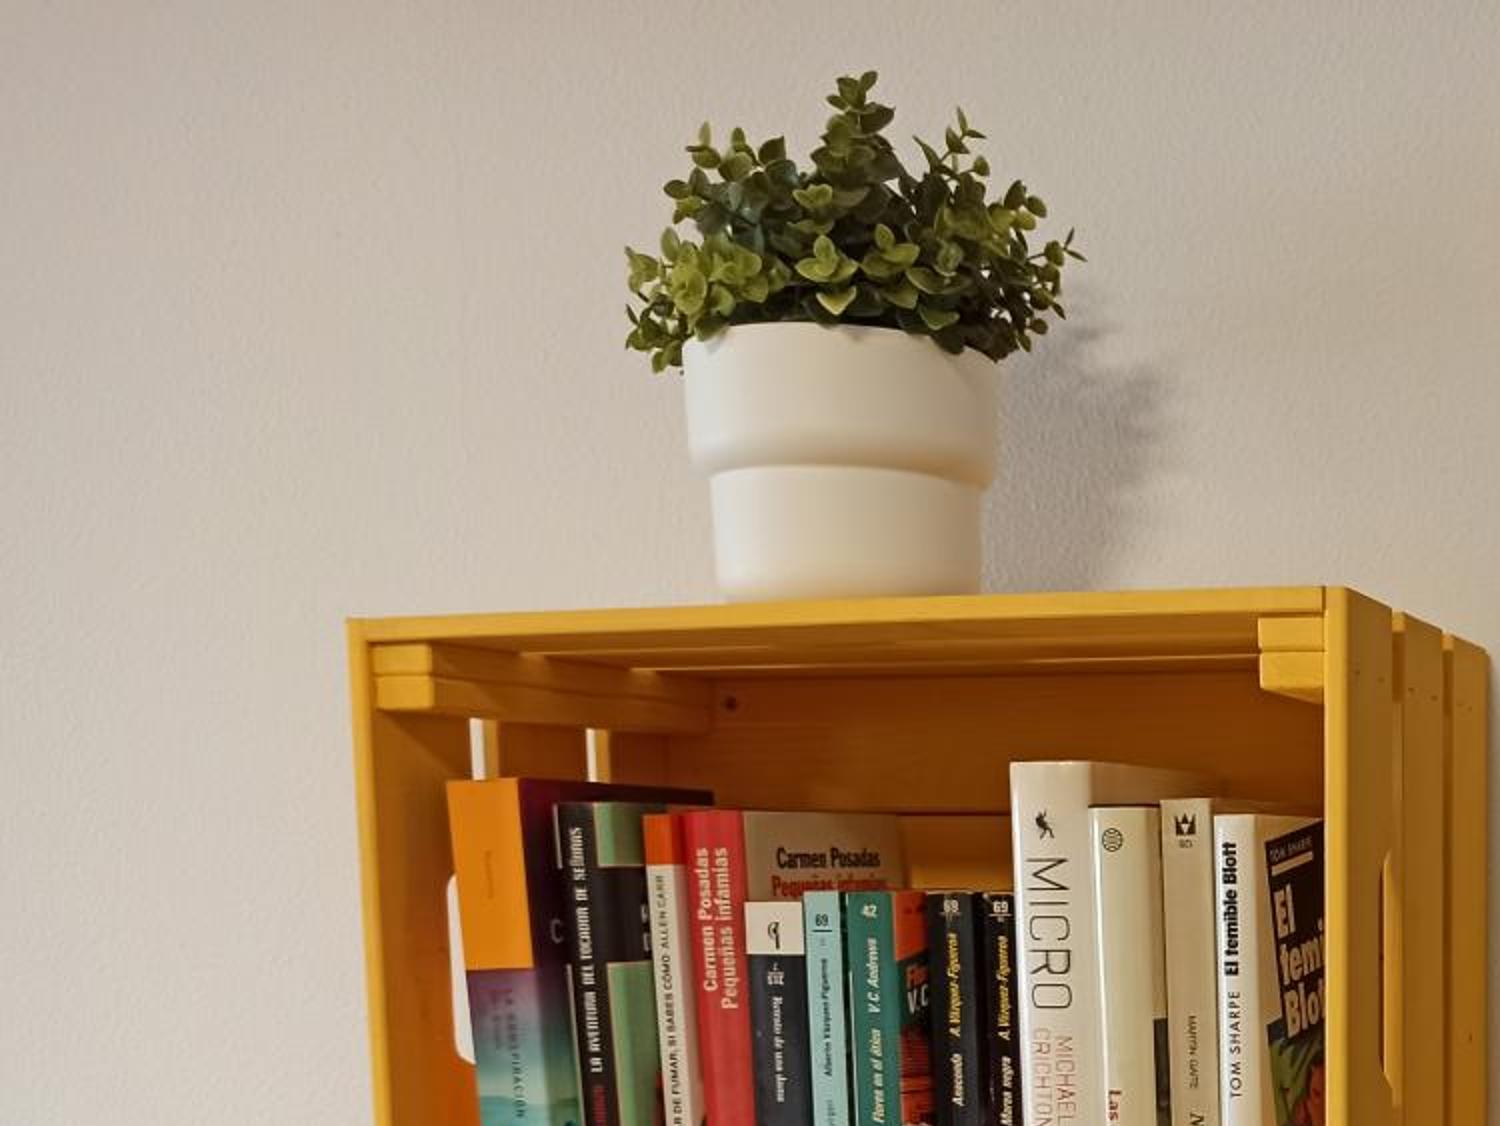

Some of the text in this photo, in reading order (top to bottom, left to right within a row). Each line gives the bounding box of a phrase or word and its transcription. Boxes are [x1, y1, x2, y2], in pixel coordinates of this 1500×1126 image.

[569, 826, 586, 881] SEÑORAS
[775, 846, 881, 869] Carmen Posadas
[574, 886, 587, 902] DE
[655, 875, 666, 909] CARR
[694, 847, 718, 991] Carmen Posadas
[712, 846, 740, 1010] Pequeñas infamias
[1273, 884, 1297, 938] El
[575, 905, 593, 959] TOCADOR
[657, 910, 670, 949] ALLEN
[1025, 856, 1073, 1010] MICRO
[580, 964, 596, 985] DEL
[865, 936, 880, 988] Andrews
[1221, 842, 1244, 1099] TOM SHARPE El temible Blott
[584, 991, 602, 1052] AVENTURA
[664, 992, 676, 1033] SABES
[772, 996, 784, 1036] Retrato
[666, 1034, 676, 1048] SI
[773, 1037, 785, 1051] de
[869, 1028, 883, 1057] ático
[590, 1057, 604, 1073] LA
[775, 1053, 785, 1072] una
[870, 1058, 883, 1071] el
[872, 1072, 884, 1087] en
[998, 1056, 1015, 1089] negra
[775, 1075, 787, 1103] dama
[950, 1053, 966, 1107] Anaconda
[671, 1098, 682, 1115] DE
[872, 1089, 886, 1124] Flores
[999, 1091, 1015, 1126] Marea
[1108, 1089, 1123, 1121] Las
